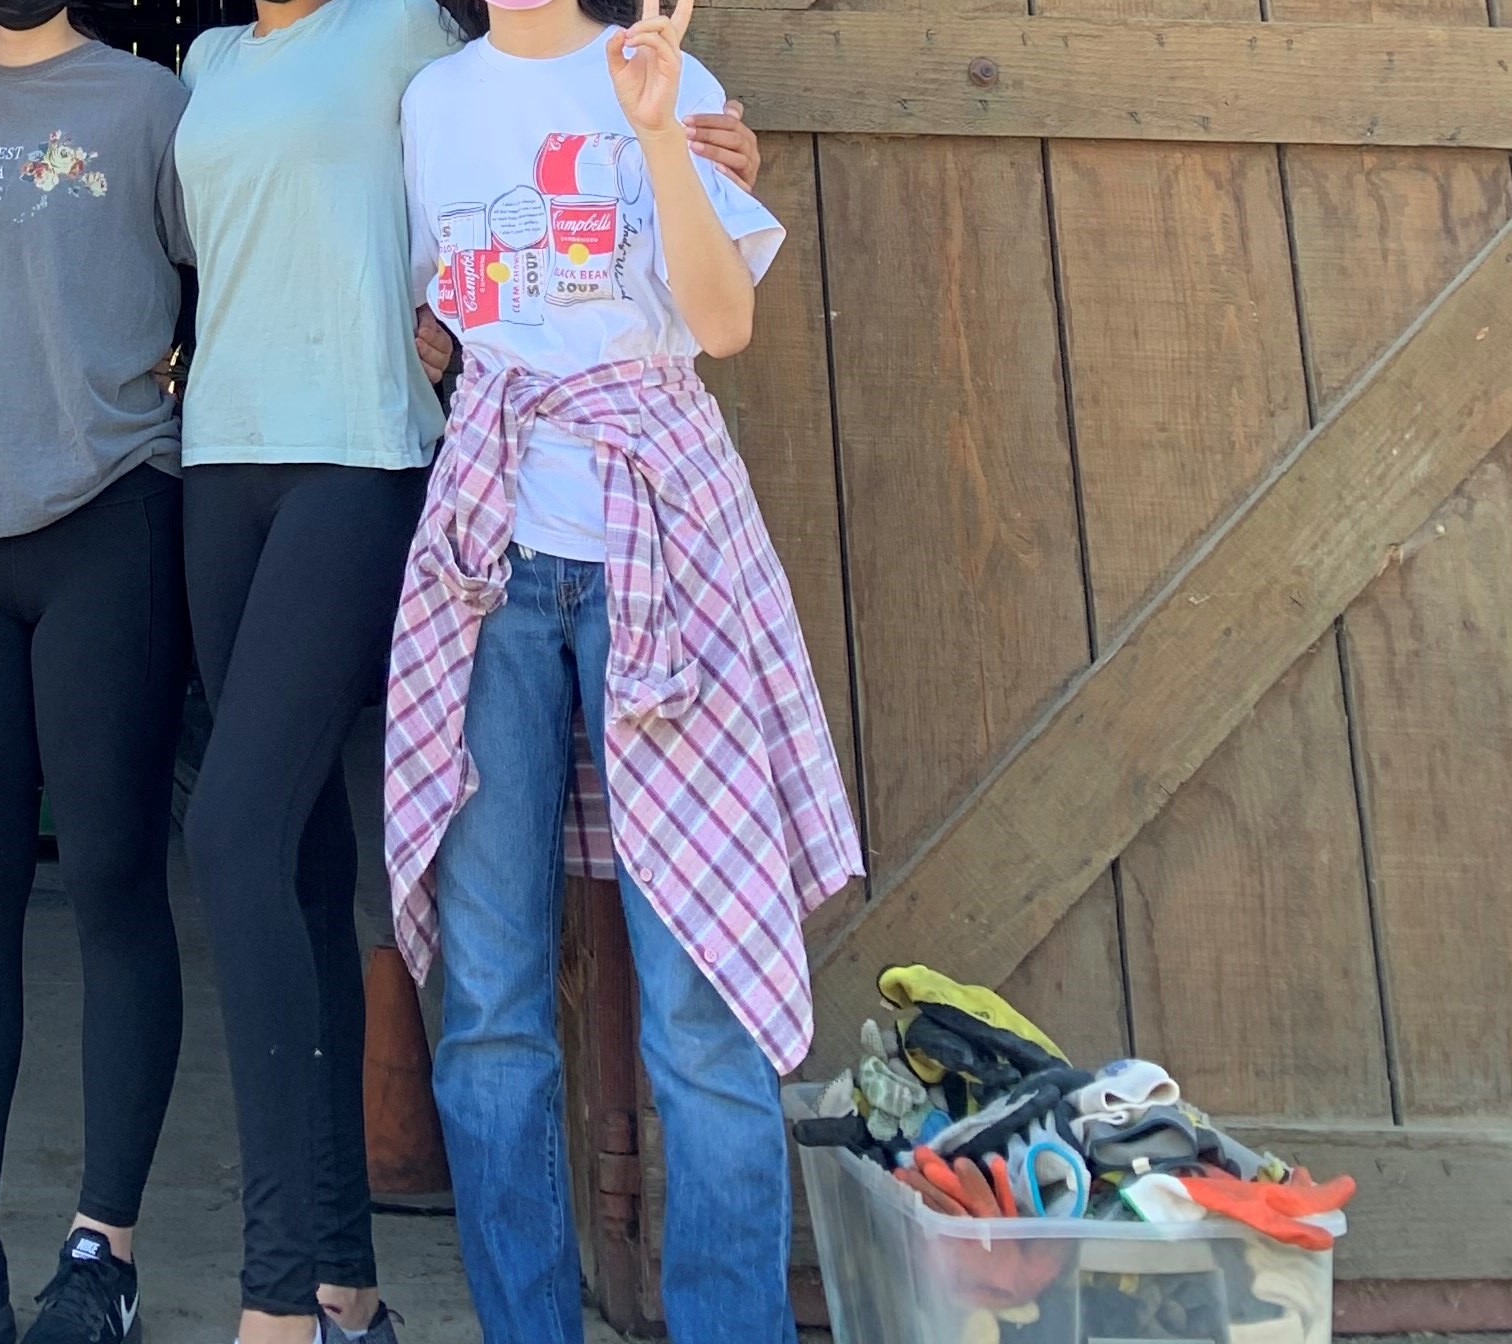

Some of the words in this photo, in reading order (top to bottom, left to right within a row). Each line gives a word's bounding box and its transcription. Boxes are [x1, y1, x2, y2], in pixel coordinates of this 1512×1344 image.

[525, 252, 540, 297] SOUP
[580, 270, 608, 280] BEAN
[557, 281, 599, 292] SOUP
